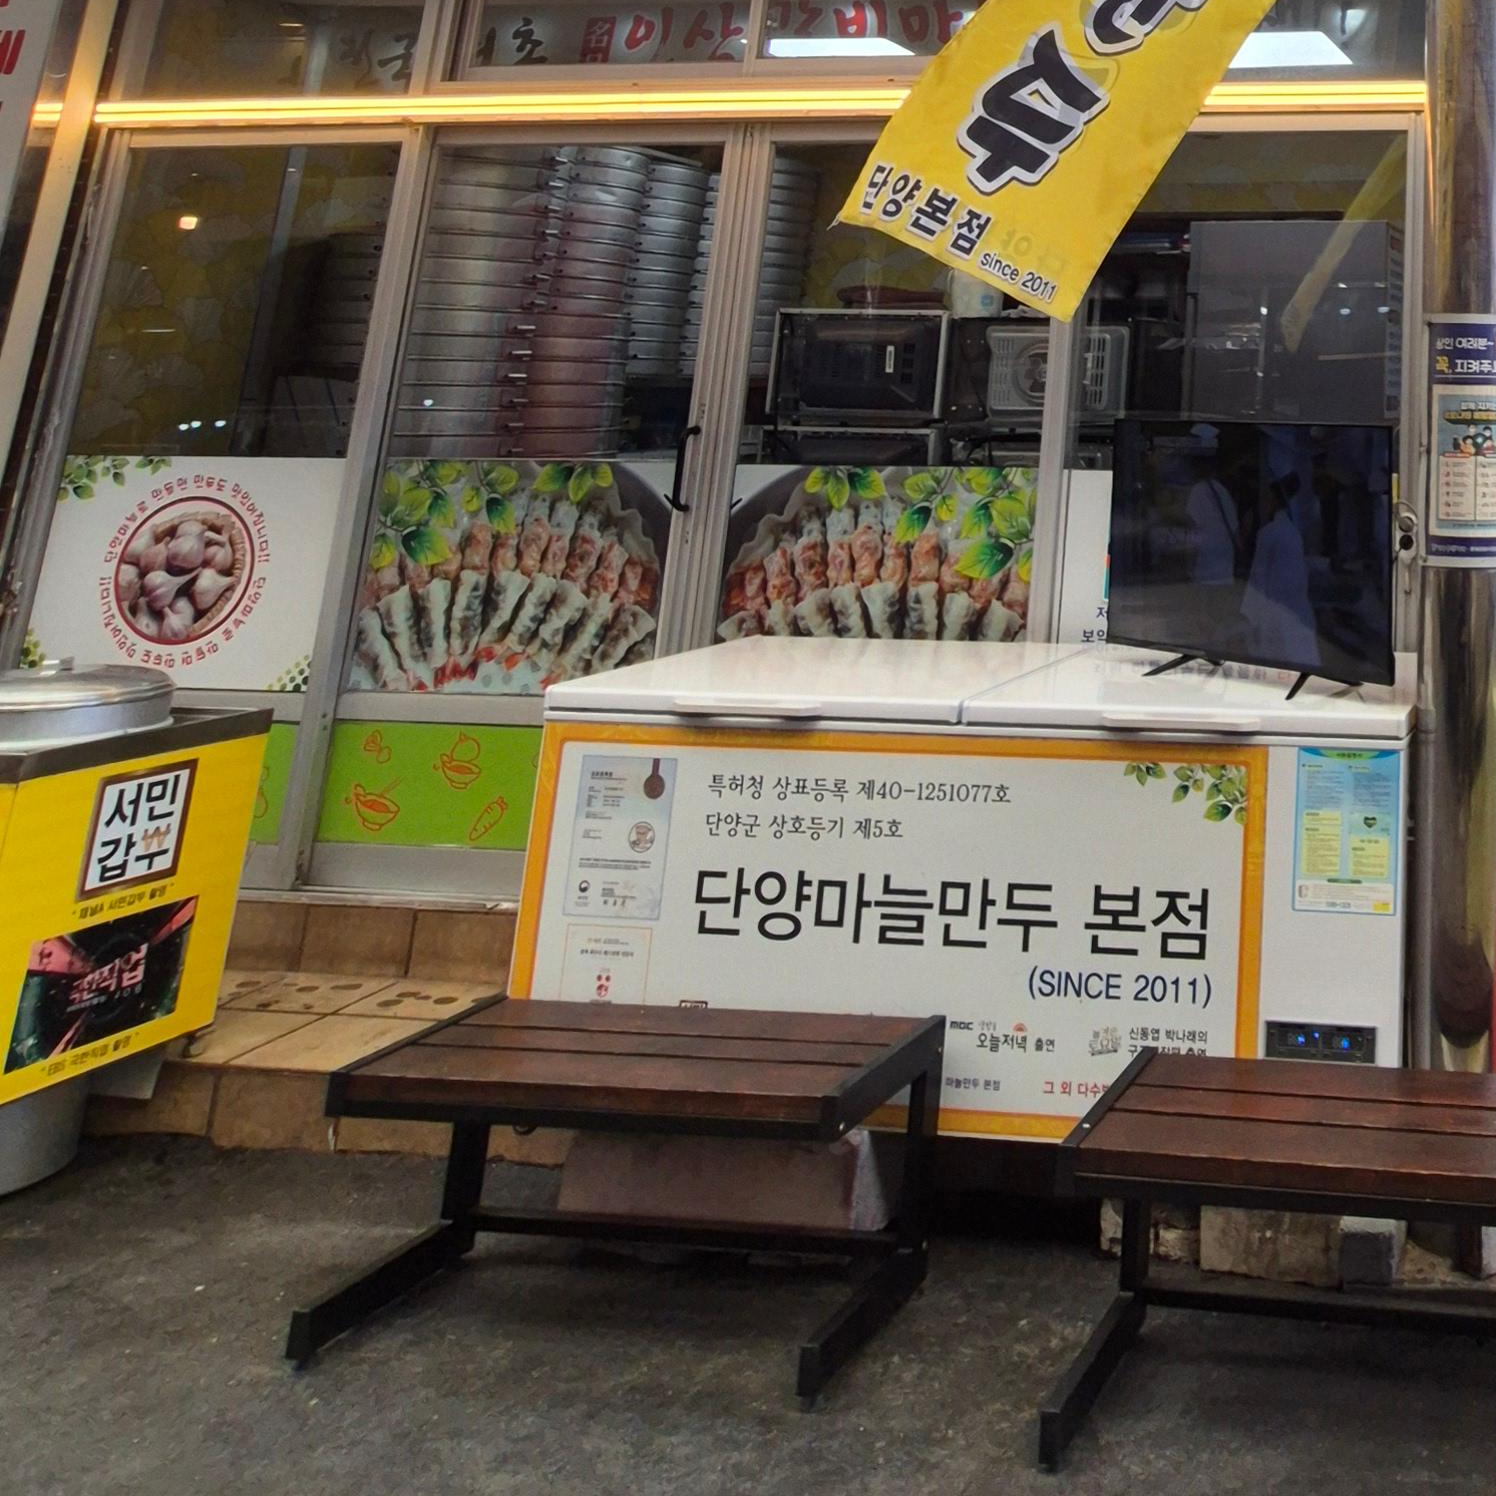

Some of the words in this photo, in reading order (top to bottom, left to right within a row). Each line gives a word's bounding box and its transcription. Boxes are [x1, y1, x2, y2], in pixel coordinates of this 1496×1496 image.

[980, 252, 1020, 281] since
[1021, 271, 1057, 301] 2011
[104, 773, 181, 829] 서민
[707, 774, 765, 801] 특허청
[772, 776, 850, 803] 상표등록
[857, 780, 1012, 804] 제40-1251077호
[705, 812, 761, 839] 단양군
[768, 813, 845, 841] 상호등기
[853, 817, 903, 840] 제5호
[694, 867, 1058, 954] 단양마늘만두
[1084, 883, 1210, 961] 본점
[1029, 965, 1122, 1000] (SINCE
[1134, 973, 1213, 1009] 2011)
[1042, 1080, 1054, 1095] 그
[1060, 1080, 1073, 1096] 외
